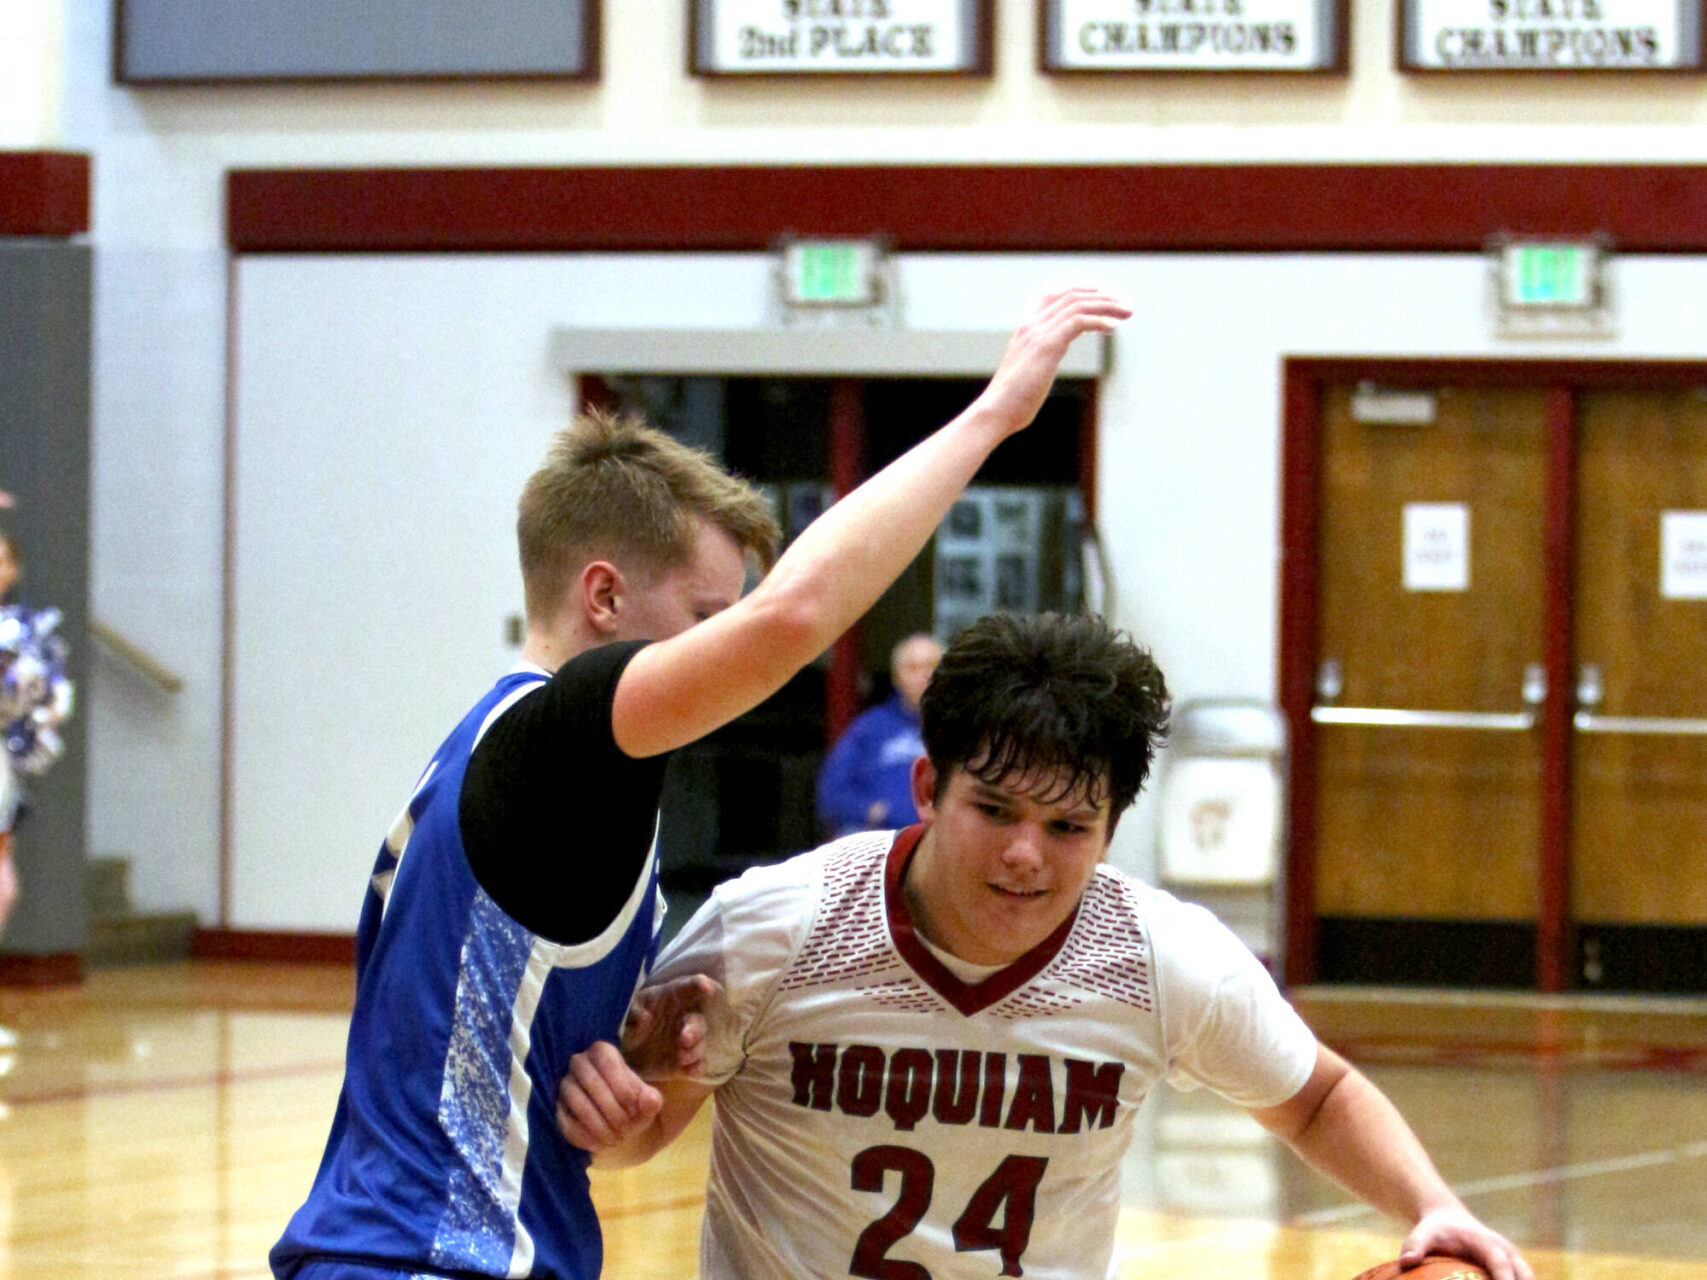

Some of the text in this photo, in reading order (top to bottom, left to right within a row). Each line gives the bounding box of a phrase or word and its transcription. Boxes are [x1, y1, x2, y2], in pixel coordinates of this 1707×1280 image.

[738, 25, 934, 57] 2nd PLACE
[1078, 21, 1297, 55] CHAMPIONS
[1436, 26, 1659, 63] CHAMPIONS
[788, 1041, 1126, 1135] HOQUIAM
